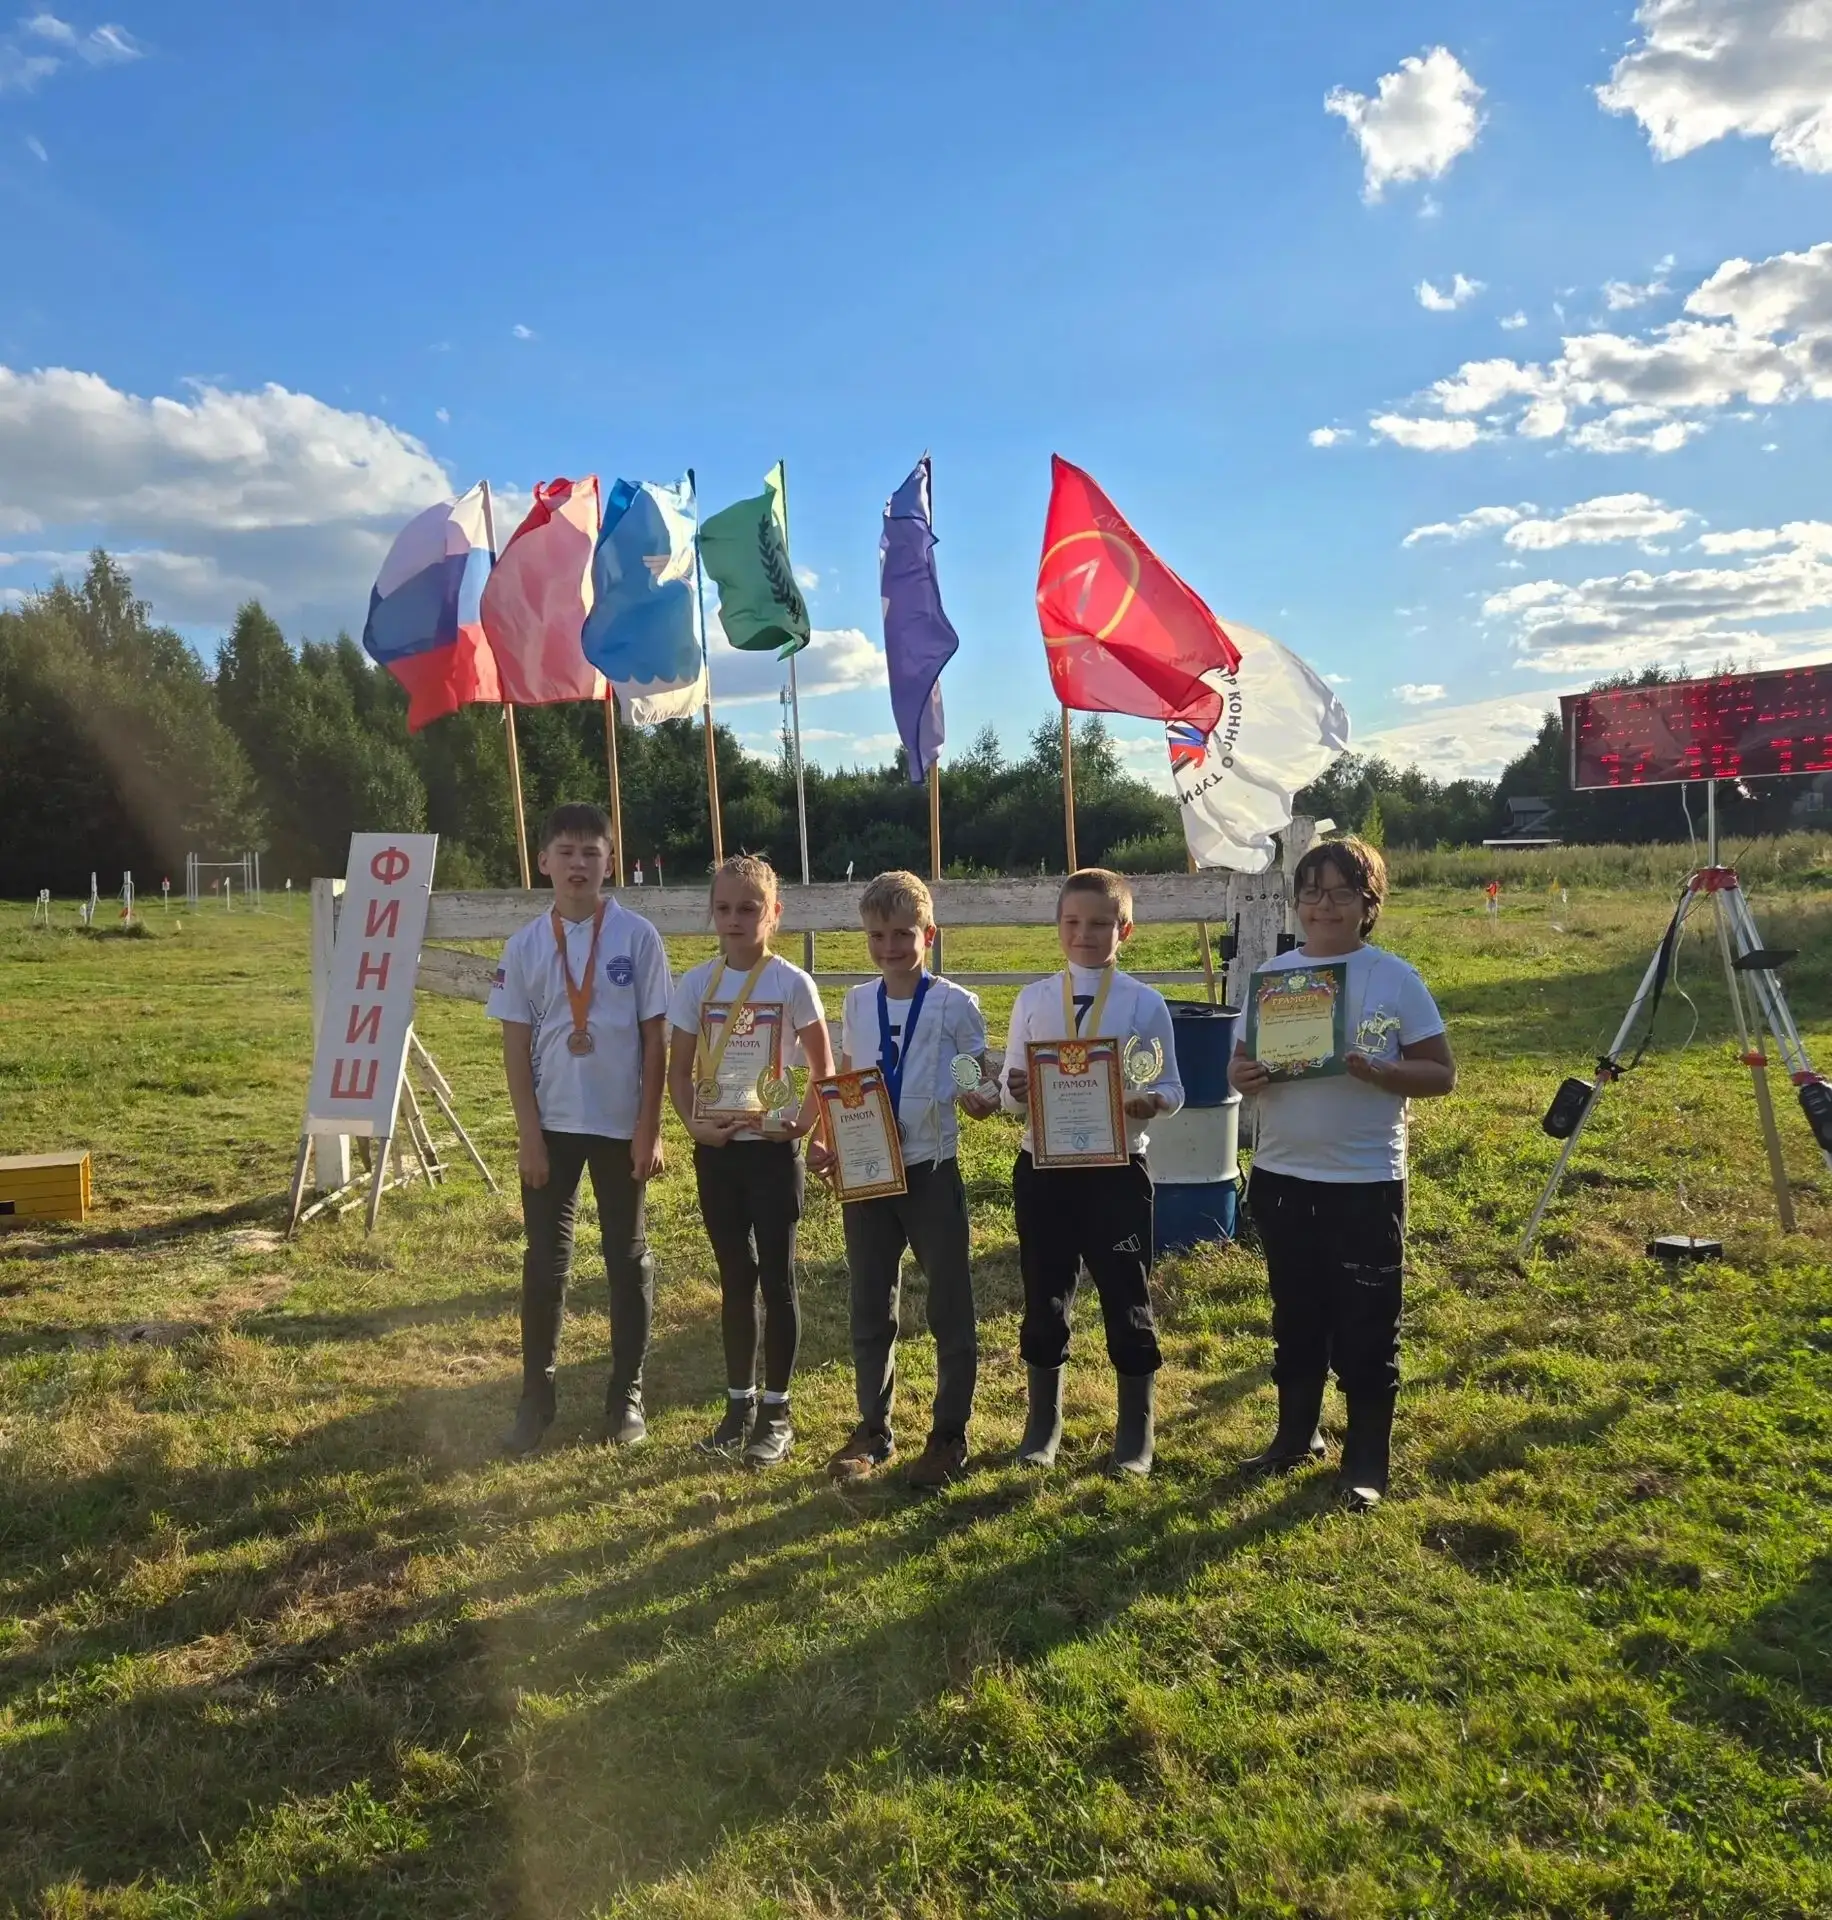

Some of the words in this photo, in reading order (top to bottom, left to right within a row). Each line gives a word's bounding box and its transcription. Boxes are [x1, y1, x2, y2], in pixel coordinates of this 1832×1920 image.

[329, 846, 411, 1099] ФИНИШ
[1072, 994, 1095, 1038] 7
[725, 1040, 761, 1049] АМОТА
[1052, 1079, 1099, 1090] ГРАМОТА
[840, 1110, 876, 1123] ГРАМОТА
